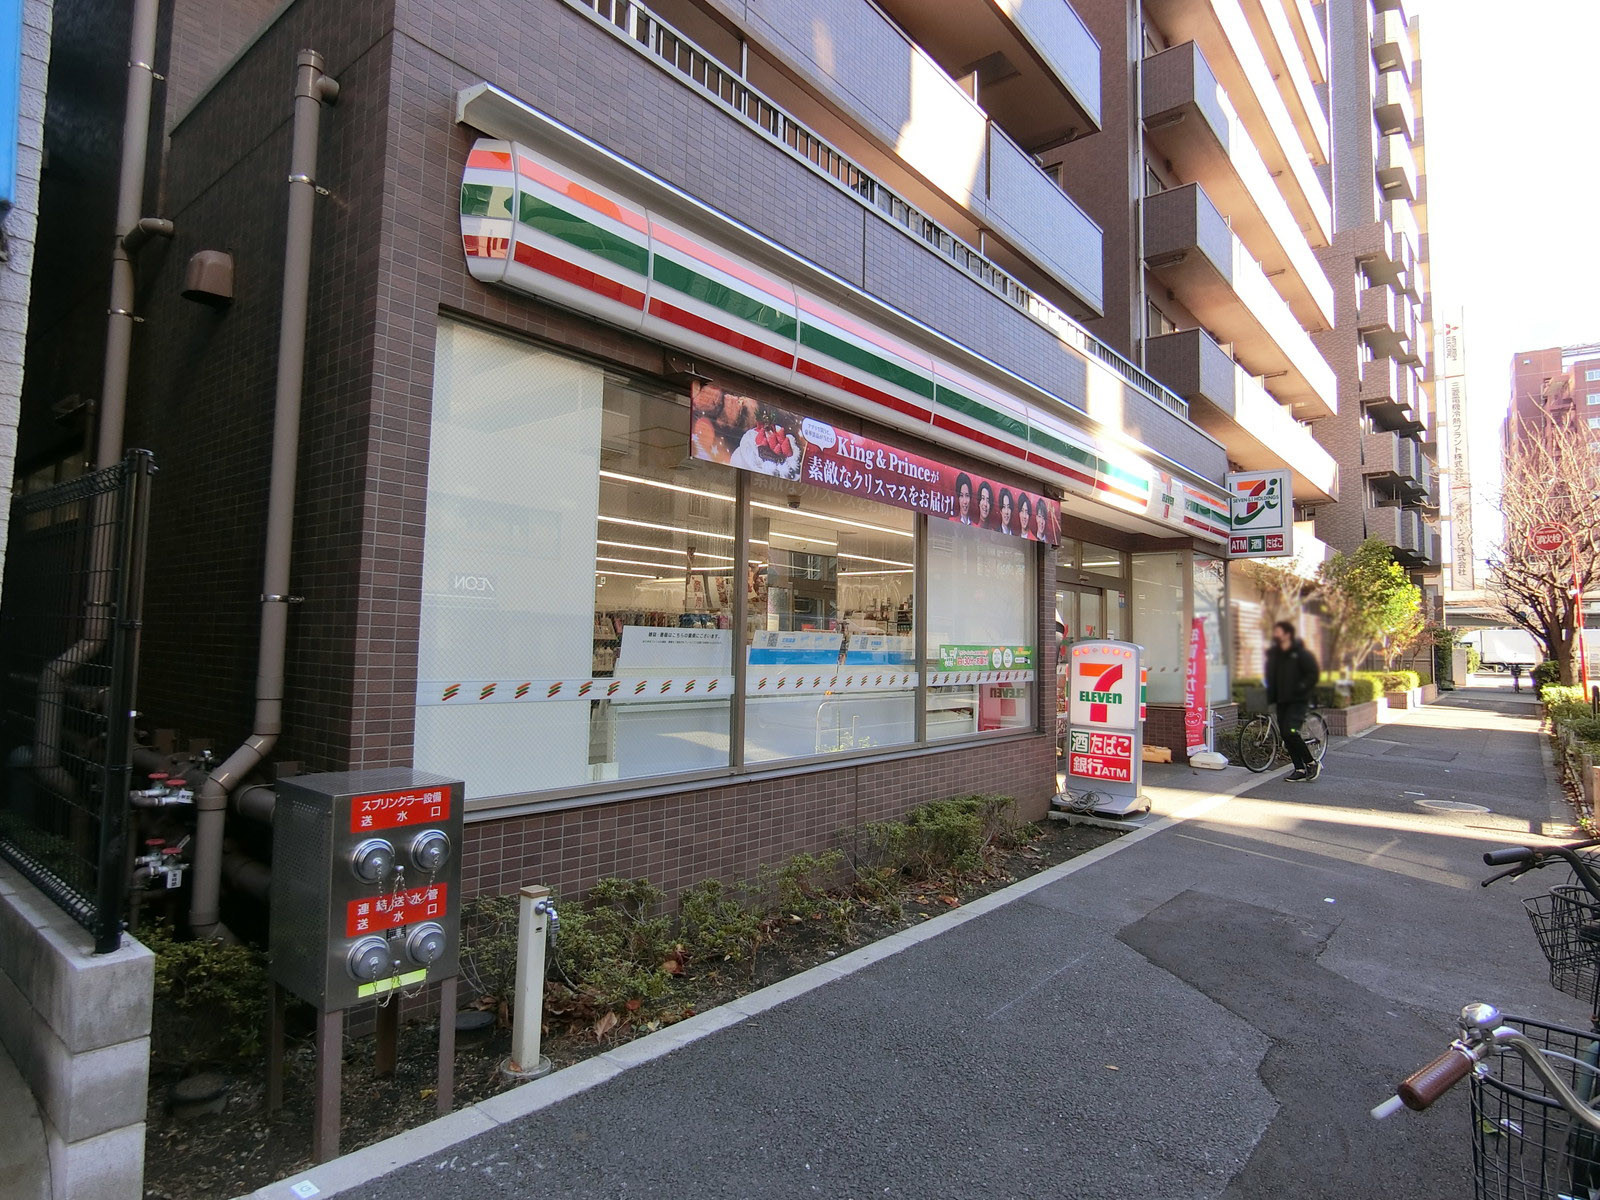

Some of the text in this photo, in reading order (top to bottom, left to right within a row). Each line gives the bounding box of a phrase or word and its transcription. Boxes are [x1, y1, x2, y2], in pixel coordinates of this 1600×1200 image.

[836, 436, 940, 483] King & Princeが
[808, 456, 955, 516] 素敵なクリスマスをお届け!
[1231, 539, 1247, 550] ATM
[1266, 537, 1283, 548] たばこ
[1536, 533, 1562, 545] 消火栓
[1071, 731, 1131, 757] 酒 たばこ
[1072, 755, 1128, 778] 銀行ATM
[361, 791, 443, 812] スプリンクラー設備
[357, 889, 439, 916] 連結送水管
